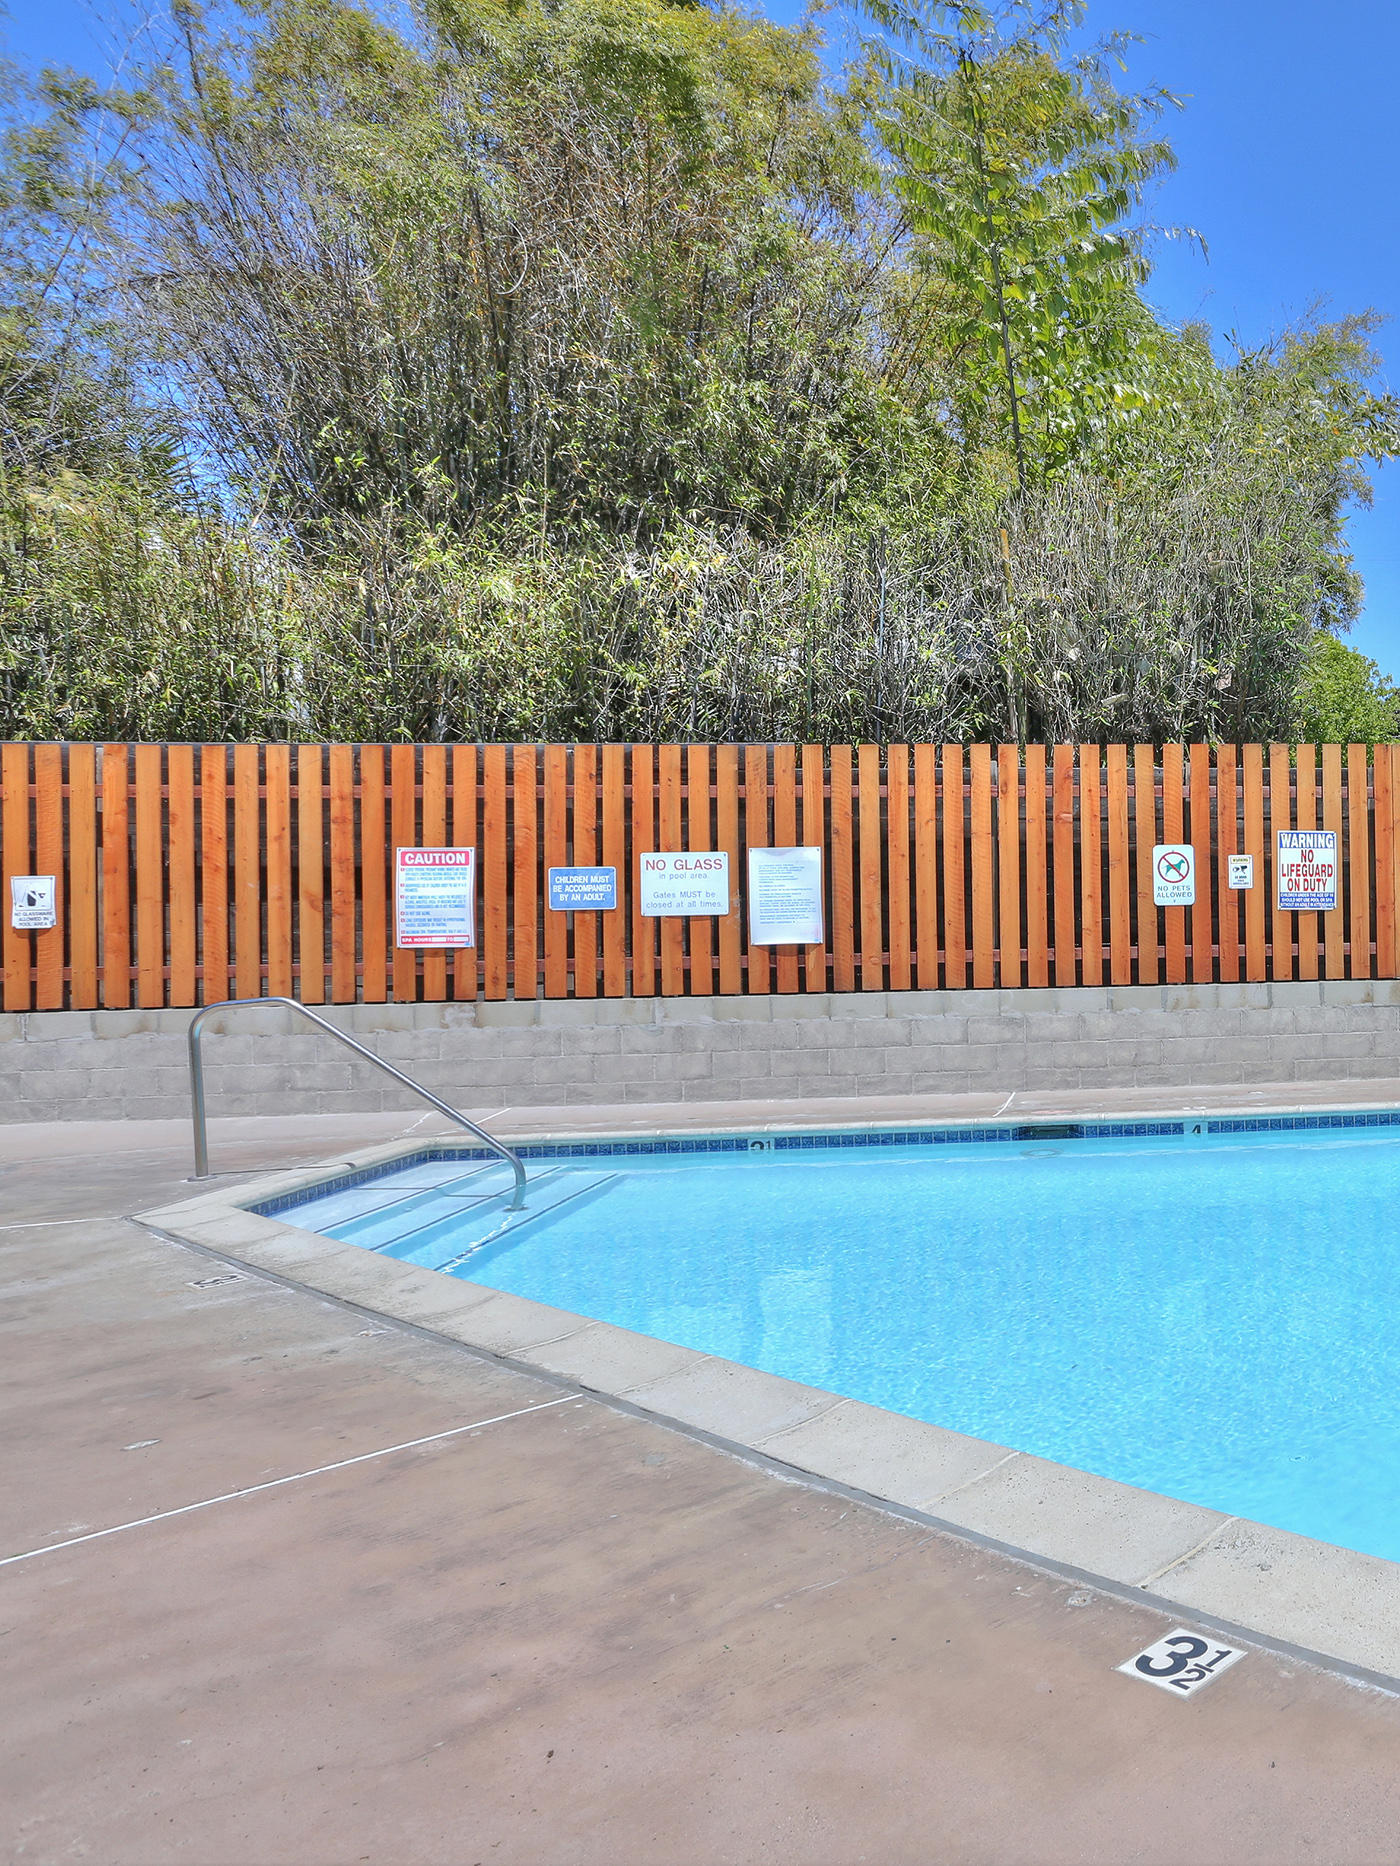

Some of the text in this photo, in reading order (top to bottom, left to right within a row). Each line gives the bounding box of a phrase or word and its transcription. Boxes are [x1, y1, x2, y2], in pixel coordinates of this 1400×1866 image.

[1280, 833, 1334, 848] WARNING
[404, 852, 466, 865] CAUTION
[1301, 849, 1314, 863] NO
[645, 858, 723, 871] NO GLASS
[1281, 863, 1334, 877] LIFEGUARD
[554, 875, 610, 884] CHILDREN MUST
[669, 872, 687, 881] pool
[553, 884, 612, 893] BE ACCOMPANIED
[1287, 878, 1328, 892] ON DUTY
[571, 893, 581, 901] AN
[653, 891, 676, 899] Gates
